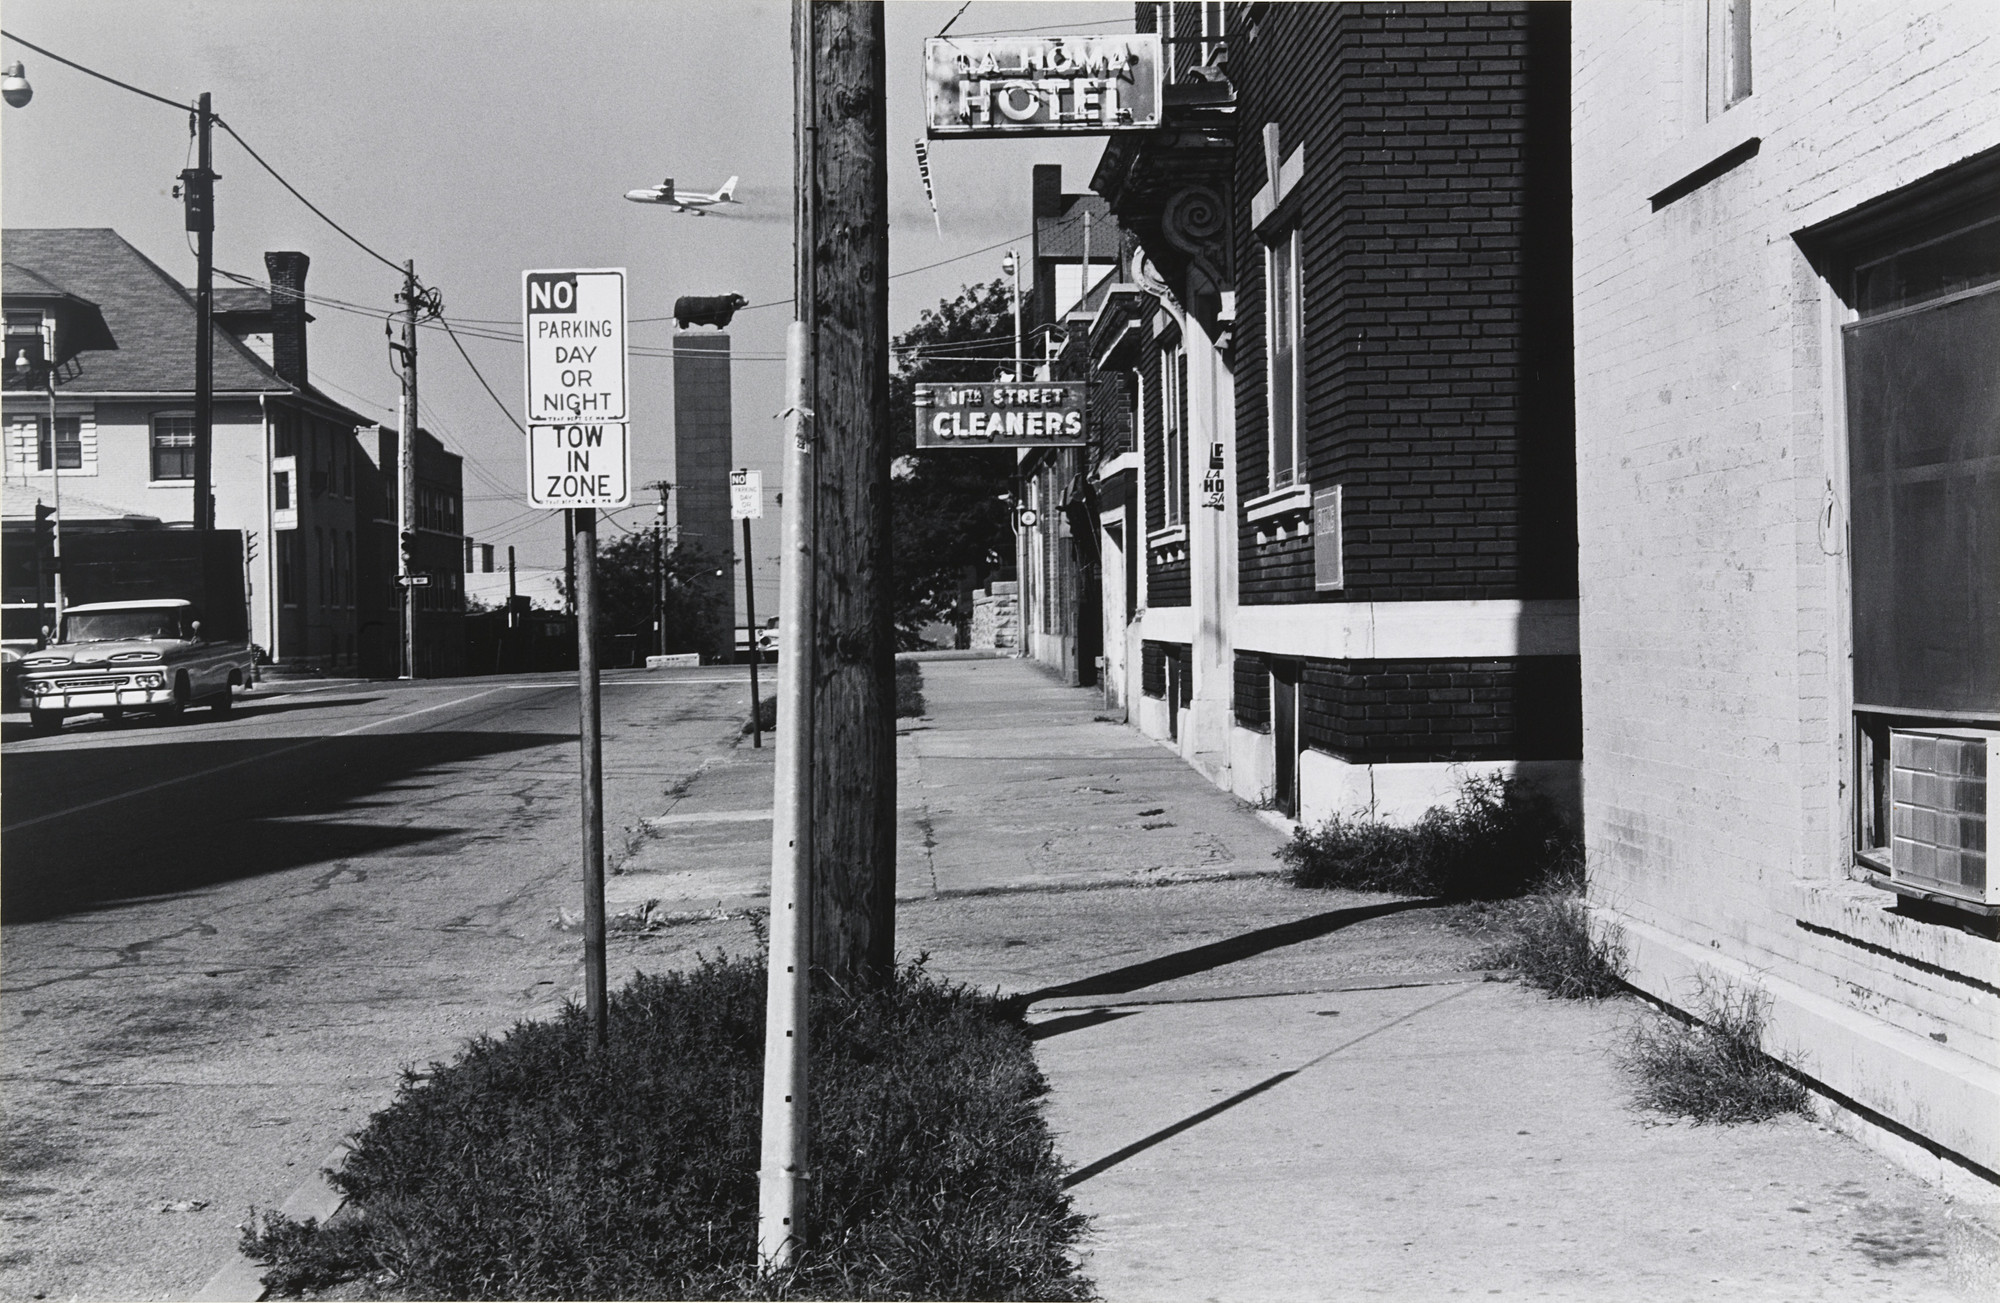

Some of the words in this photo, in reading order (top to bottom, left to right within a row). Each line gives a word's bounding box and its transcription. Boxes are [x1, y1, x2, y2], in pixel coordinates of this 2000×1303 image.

[958, 78, 1133, 121] HOTEL
[530, 281, 574, 310] NO
[538, 320, 612, 338] PARKING
[555, 346, 597, 364] DAY
[561, 370, 592, 387] OR
[544, 392, 612, 411] NIGHT
[993, 388, 1063, 405] STREET
[933, 411, 1082, 436] CLEANERS
[552, 425, 603, 448] TOW
[568, 451, 589, 473] IN
[732, 475, 746, 484] NO
[1206, 470, 1220, 479] LA
[547, 475, 611, 497] ZONE
